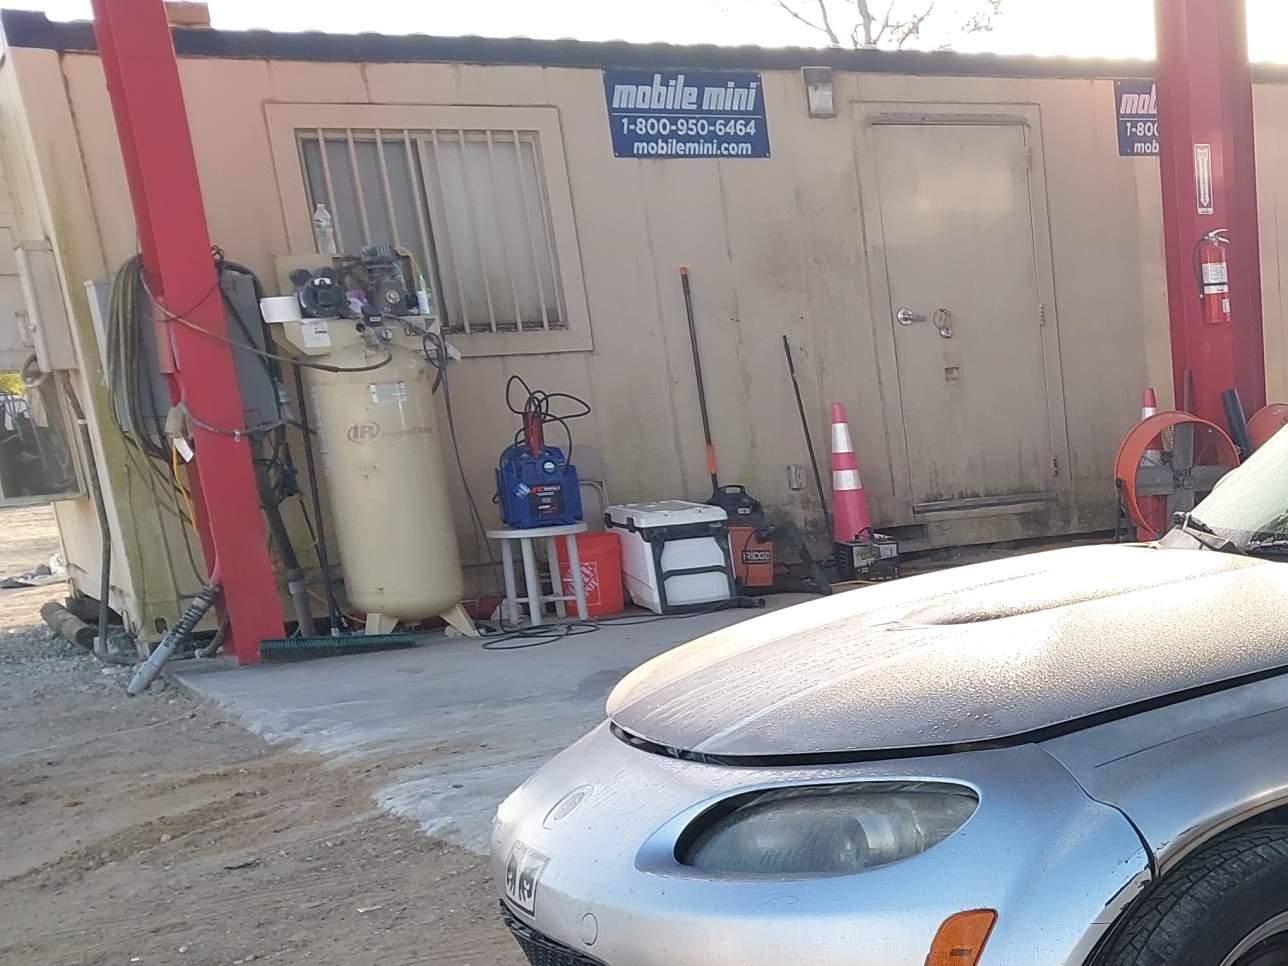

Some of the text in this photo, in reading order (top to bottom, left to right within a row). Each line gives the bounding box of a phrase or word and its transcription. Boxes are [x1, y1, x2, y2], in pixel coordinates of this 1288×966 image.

[612, 74, 757, 111] mobile mini
[621, 118, 756, 136] 1-800-950-6464
[633, 138, 752, 155] mobilemini.com
